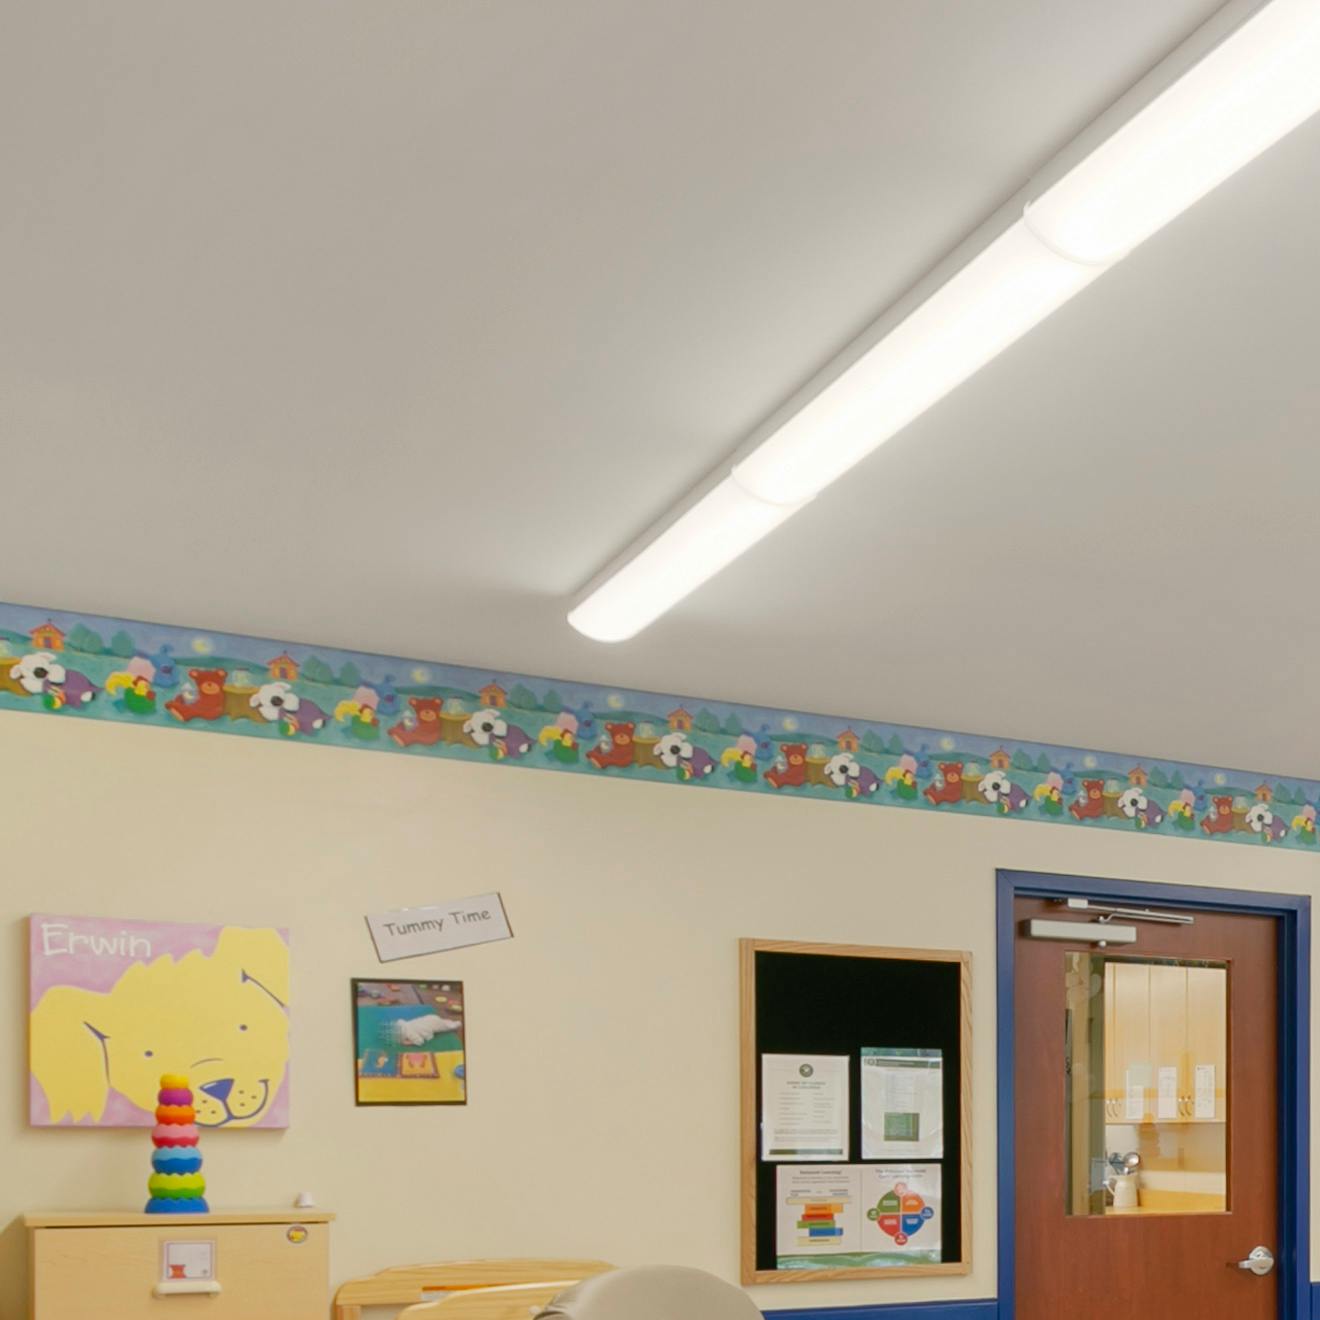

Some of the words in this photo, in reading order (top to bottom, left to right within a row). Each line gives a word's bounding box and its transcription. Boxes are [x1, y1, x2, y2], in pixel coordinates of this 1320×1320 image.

[382, 918, 444, 936] Tummy
[448, 909, 491, 925] Time
[41, 922, 152, 957] Erwin
